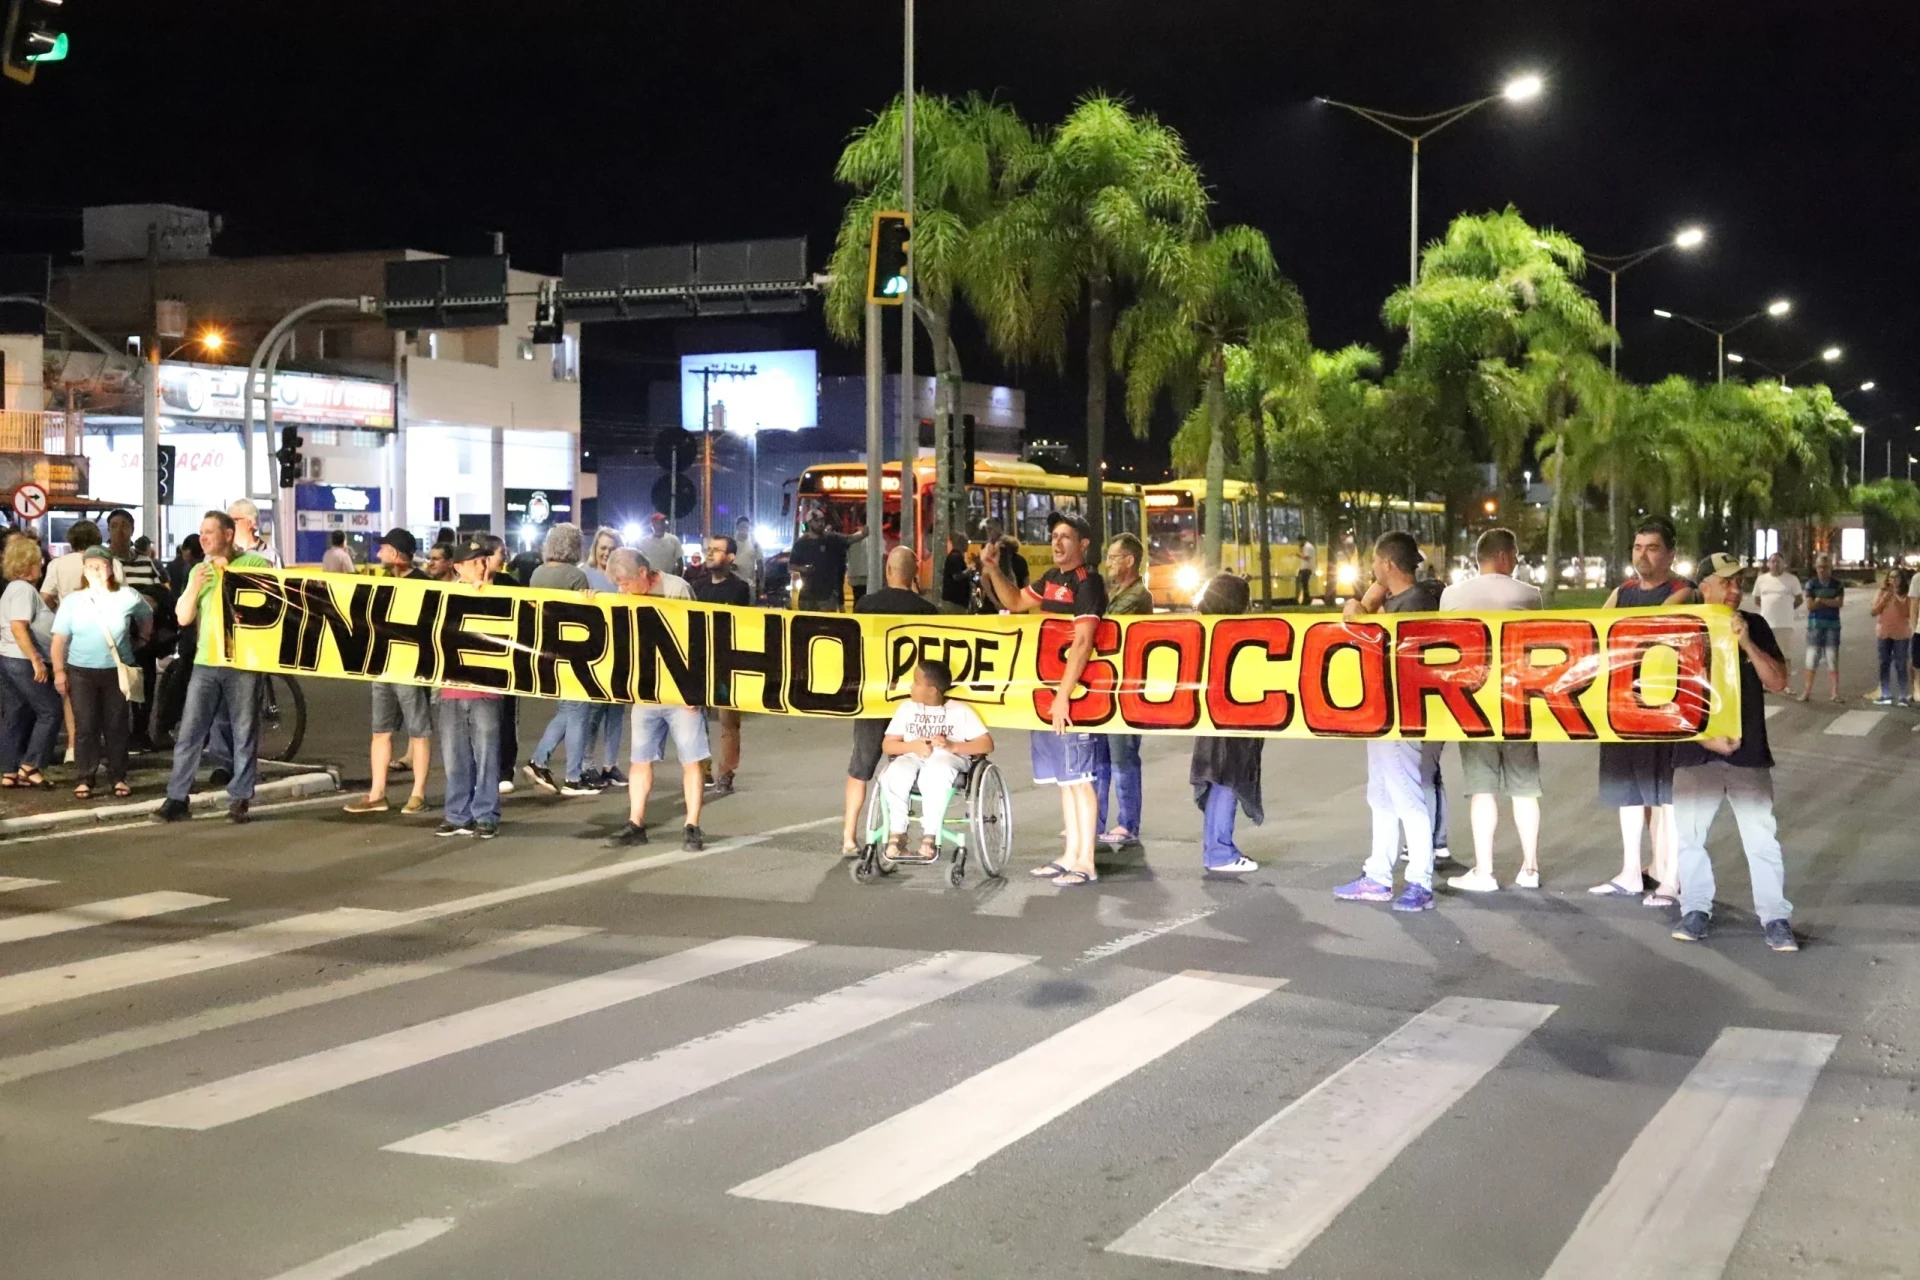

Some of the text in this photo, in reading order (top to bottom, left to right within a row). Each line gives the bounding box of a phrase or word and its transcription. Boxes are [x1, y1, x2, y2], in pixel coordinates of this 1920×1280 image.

[222, 570, 866, 717] PINHEIRINHO
[1032, 614, 1712, 740] SOCORRO
[914, 713, 946, 724] TOKYO
